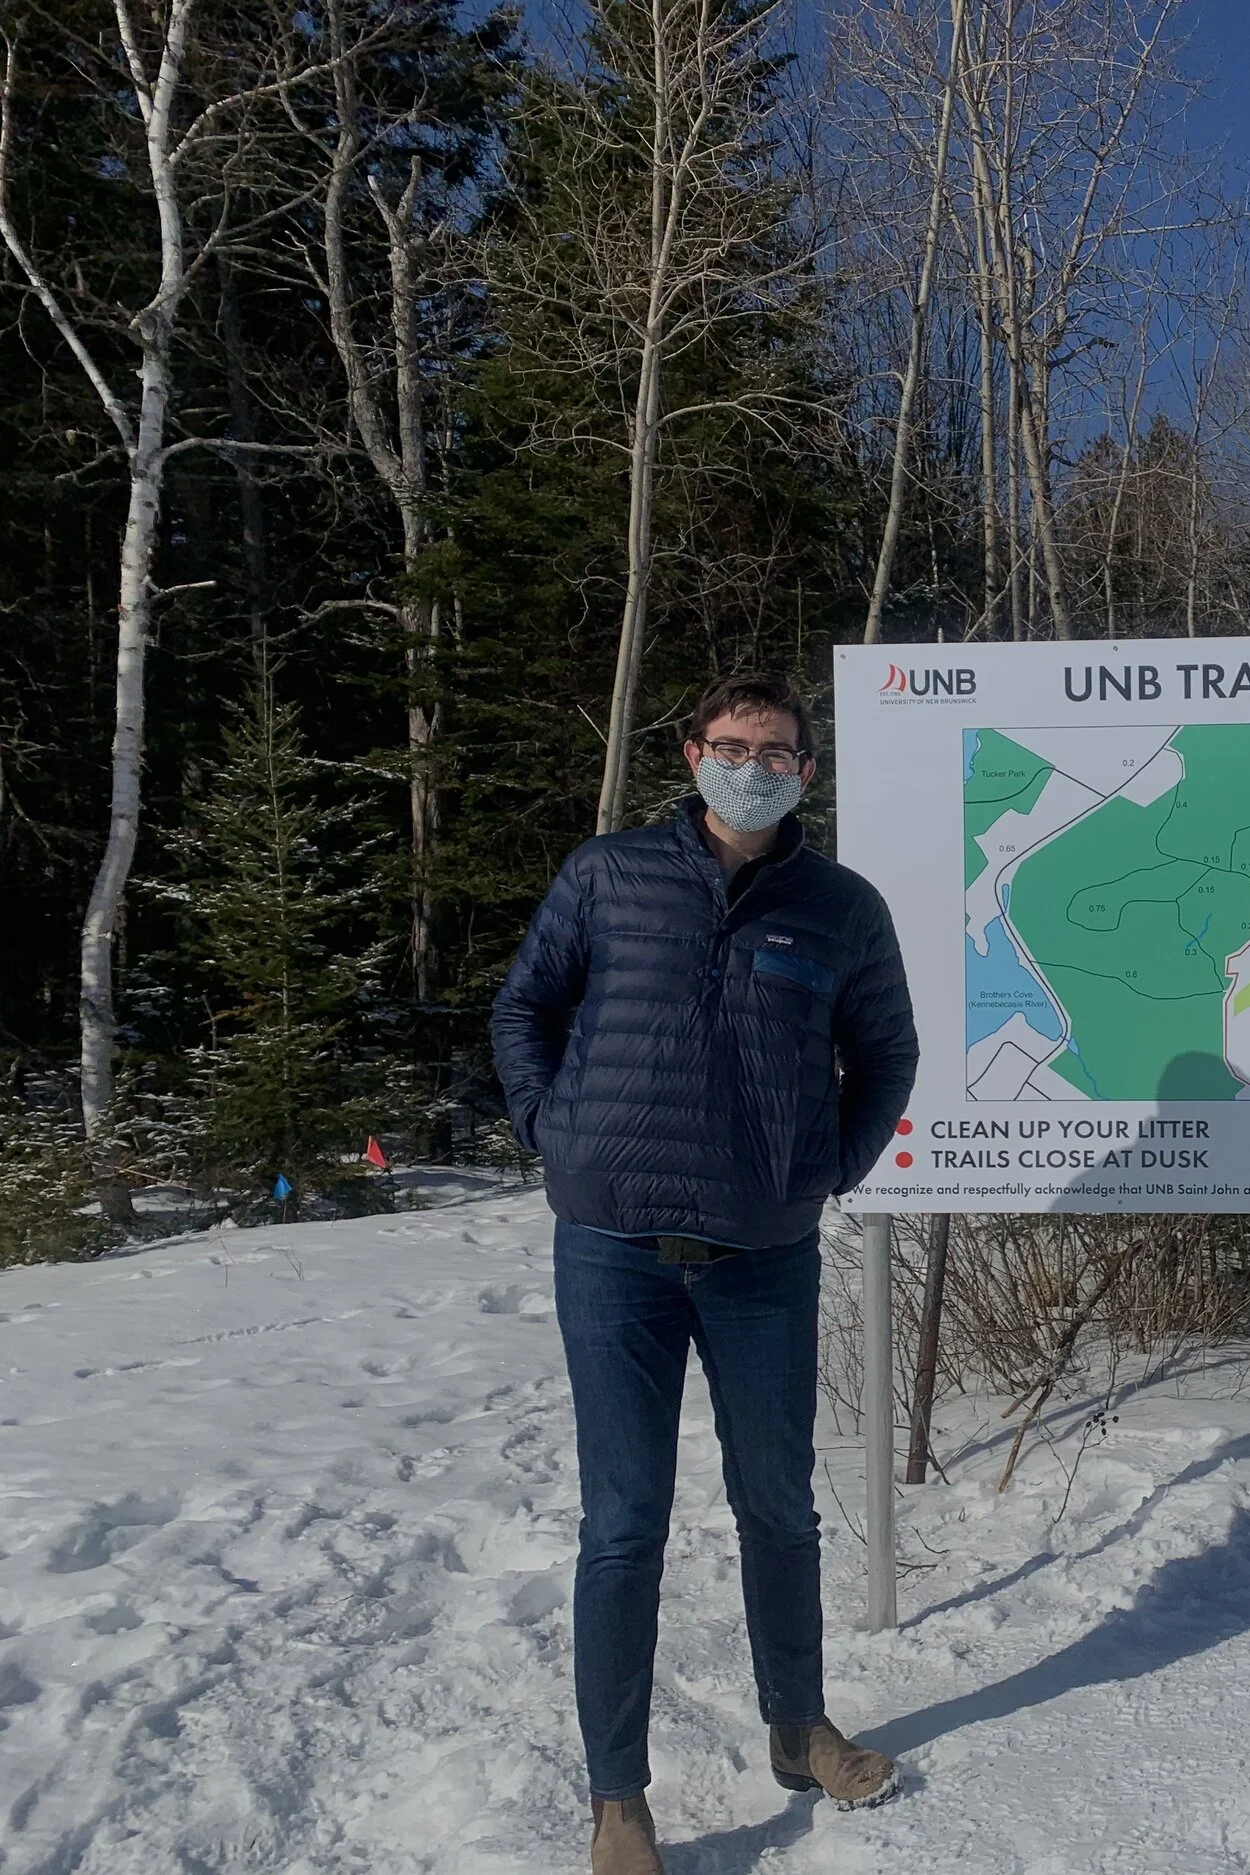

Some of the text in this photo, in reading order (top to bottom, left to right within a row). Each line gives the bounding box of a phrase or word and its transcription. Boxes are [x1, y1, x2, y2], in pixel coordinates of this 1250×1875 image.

[910, 669, 976, 695] UNB
[1064, 665, 1162, 702] UNB
[981, 770, 1006, 778] Tucker
[1185, 948, 1197, 956] 0.3
[930, 1120, 1210, 1139] CLEAN UP YOUR LITTER
[931, 1150, 1209, 1169] TRAILS CLOSE AT DUSK
[852, 1185, 872, 1194] We
[876, 1184, 933, 1197] recognize
[937, 1183, 959, 1194] and
[963, 1183, 1031, 1197] respectfully
[1035, 1183, 1115, 1197] acknowledge
[1119, 1183, 1142, 1194] that
[1146, 1184, 1174, 1195] UNB
[1178, 1184, 1208, 1195] Saint
[1211, 1184, 1239, 1195] John
